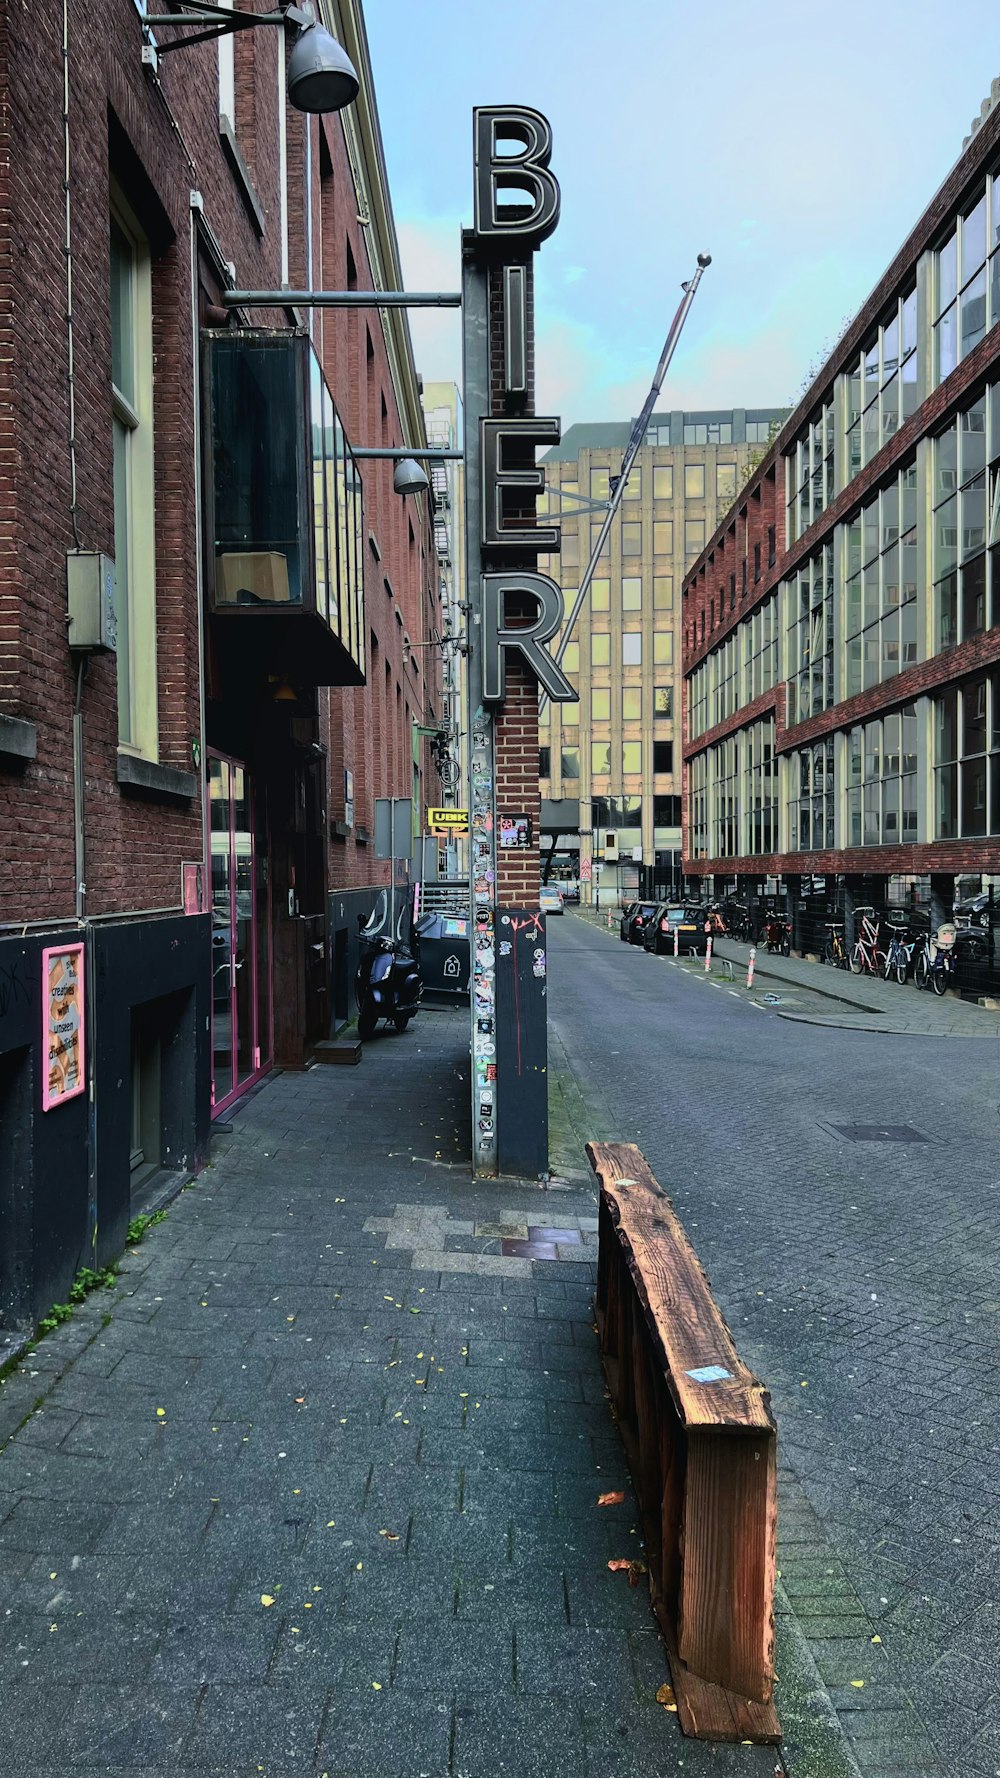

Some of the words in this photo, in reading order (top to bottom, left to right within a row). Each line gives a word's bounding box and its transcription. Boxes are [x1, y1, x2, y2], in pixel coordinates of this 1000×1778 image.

[473, 105, 579, 702] BIER
[435, 813, 467, 822] UBIK
[51, 985, 75, 997] creatives
[54, 1022, 74, 1034] unseen
